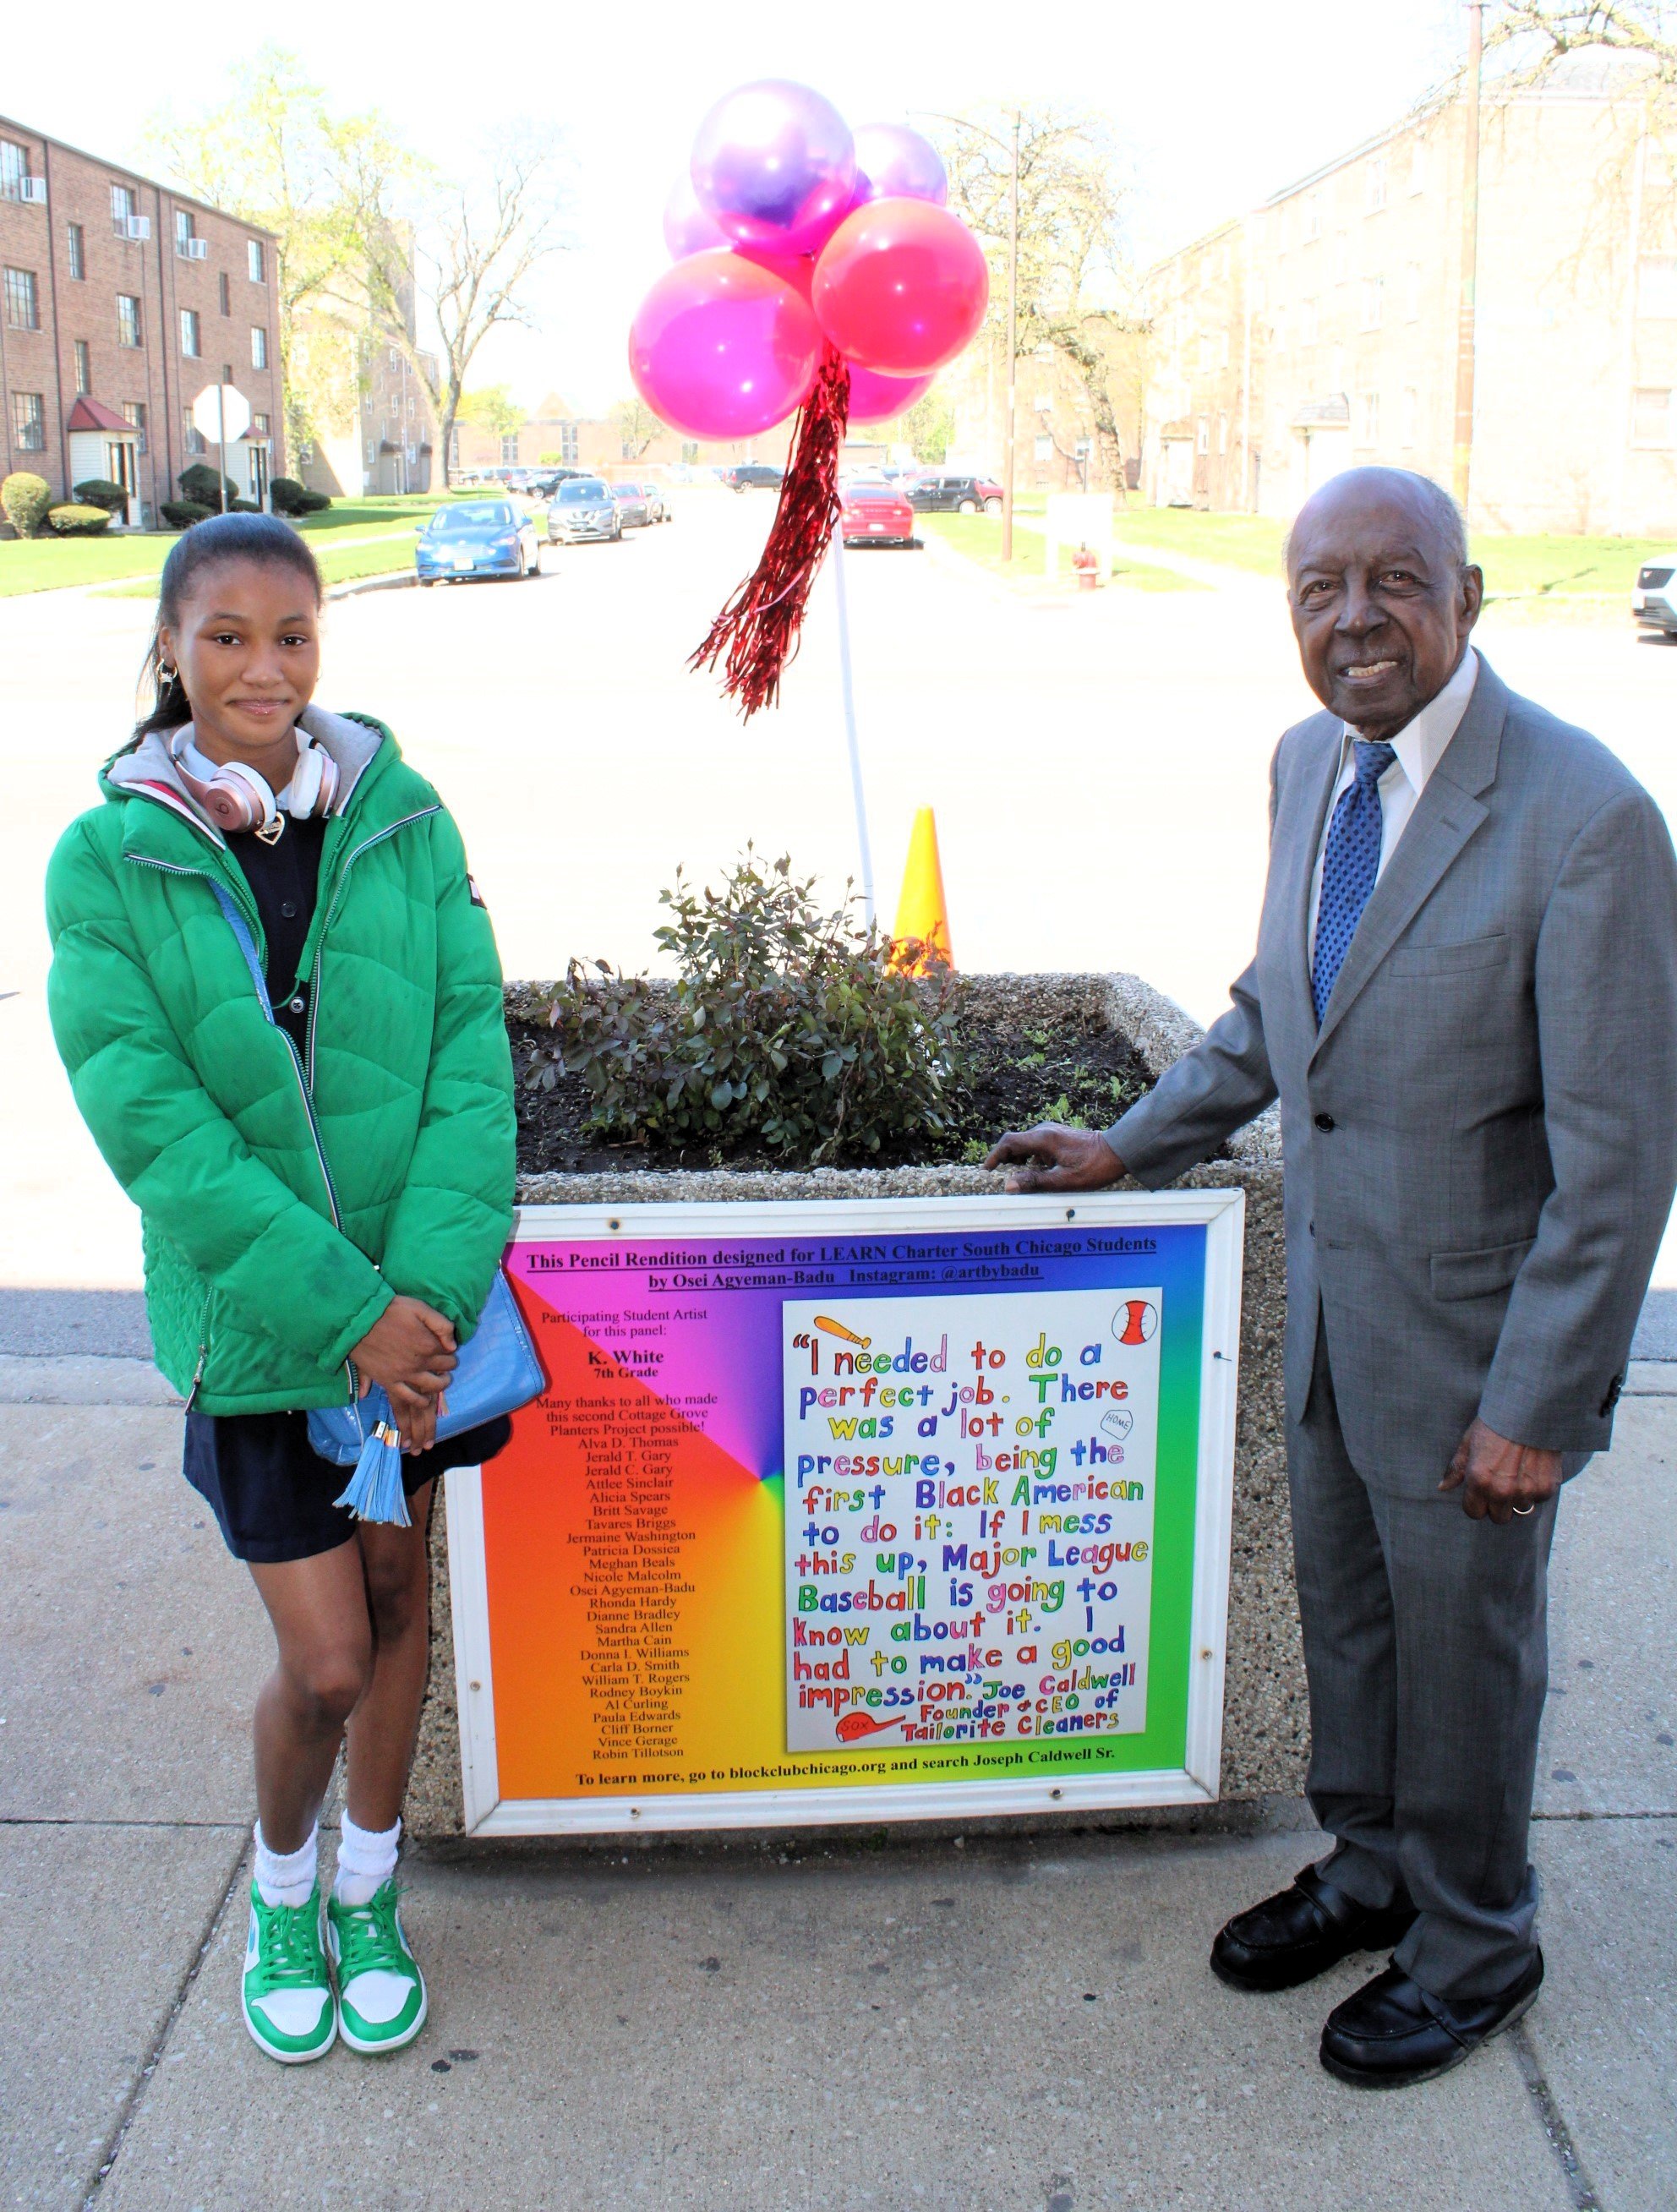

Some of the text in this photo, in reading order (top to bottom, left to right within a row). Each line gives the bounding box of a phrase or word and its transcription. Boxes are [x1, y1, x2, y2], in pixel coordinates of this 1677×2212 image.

[527, 1237, 1157, 1268] This Pencil Rendition designed for LEARN Charter South Chicago Students
[648, 1263, 1039, 1290] by Osei Agyeman-Badu Instagram: @artbybadu
[541, 1308, 707, 1324] Participating Student Artist
[583, 1325, 667, 1338] for this panel:
[588, 1349, 664, 1365] K. White
[834, 1333, 948, 1376] needed
[971, 1341, 1006, 1370] to
[1026, 1332, 1062, 1368] do
[1079, 1342, 1101, 1365] a
[594, 1367, 658, 1379] 7th Grade
[536, 1393, 718, 1411] Many thanks to all who made
[800, 1373, 1128, 1419] perfect job. There
[546, 1408, 708, 1423] this second Cottage Grove
[1106, 1413, 1131, 1430] HOME
[550, 1421, 705, 1437] Planters Project possible!
[828, 1406, 1055, 1440] was a lot of
[578, 1437, 679, 1449] Alva D. Thomas
[586, 1451, 671, 1464] Jerald T. Gary
[798, 1437, 1124, 1488] pressure, being the
[585, 1464, 673, 1478] Jerald C. Gary
[586, 1477, 674, 1489] Attlee Sinclair
[590, 1491, 671, 1504] Alicia Spears
[803, 1475, 1144, 1515] first Black American
[593, 1505, 669, 1517] Britt Savage
[586, 1518, 676, 1530] Tavares Briggs
[803, 1521, 839, 1546] to
[860, 1516, 897, 1543] do
[981, 1510, 1005, 1538] If
[1022, 1510, 1029, 1535] I
[1039, 1513, 1112, 1534] mess
[566, 1532, 696, 1543] Jermaine Washington
[583, 1545, 629, 1556] Patricia
[589, 1557, 675, 1571] Meghan Beals
[795, 1539, 1149, 1581] this up, Major League
[583, 1570, 681, 1582] Nicole Malcolm
[570, 1582, 696, 1598] Osei Agyeman-Badu
[798, 1576, 1118, 1614] Baseball is going to
[590, 1596, 677, 1608] Rhonda Hardy
[587, 1609, 680, 1622] Dianne Bradley
[595, 1622, 673, 1634] Sandra Allen
[890, 1611, 986, 1641] about
[1007, 1608, 1041, 1635] it.
[1086, 1606, 1093, 1632] I
[598, 1635, 672, 1647] Martha Cain
[581, 1651, 620, 1660] Donna
[636, 1647, 690, 1658] Williams
[793, 1625, 1125, 1680] had to make a good
[591, 1660, 680, 1673] Carla D. Smith
[582, 1673, 690, 1685] William T. Rogers
[982, 1680, 1025, 1700] Joe
[1039, 1662, 1136, 1694] Caldwell
[590, 1685, 682, 1699] Rodney Boykin
[605, 1699, 669, 1710] Al Curling
[920, 1700, 1010, 1723] Founder
[1035, 1693, 1079, 1715] CEO
[1095, 1688, 1119, 1709] of
[593, 1711, 680, 1723] Paula Edwards
[601, 1723, 674, 1734] Cliff Borner
[901, 1712, 1119, 1742] Tailorite Cleaners
[598, 1737, 631, 1747] Vince
[593, 1747, 684, 1760] Robin Tillotson
[576, 1747, 1115, 1786] To learn more, go to blockclubchicago.org and search Joseph Caldwell Sr.
